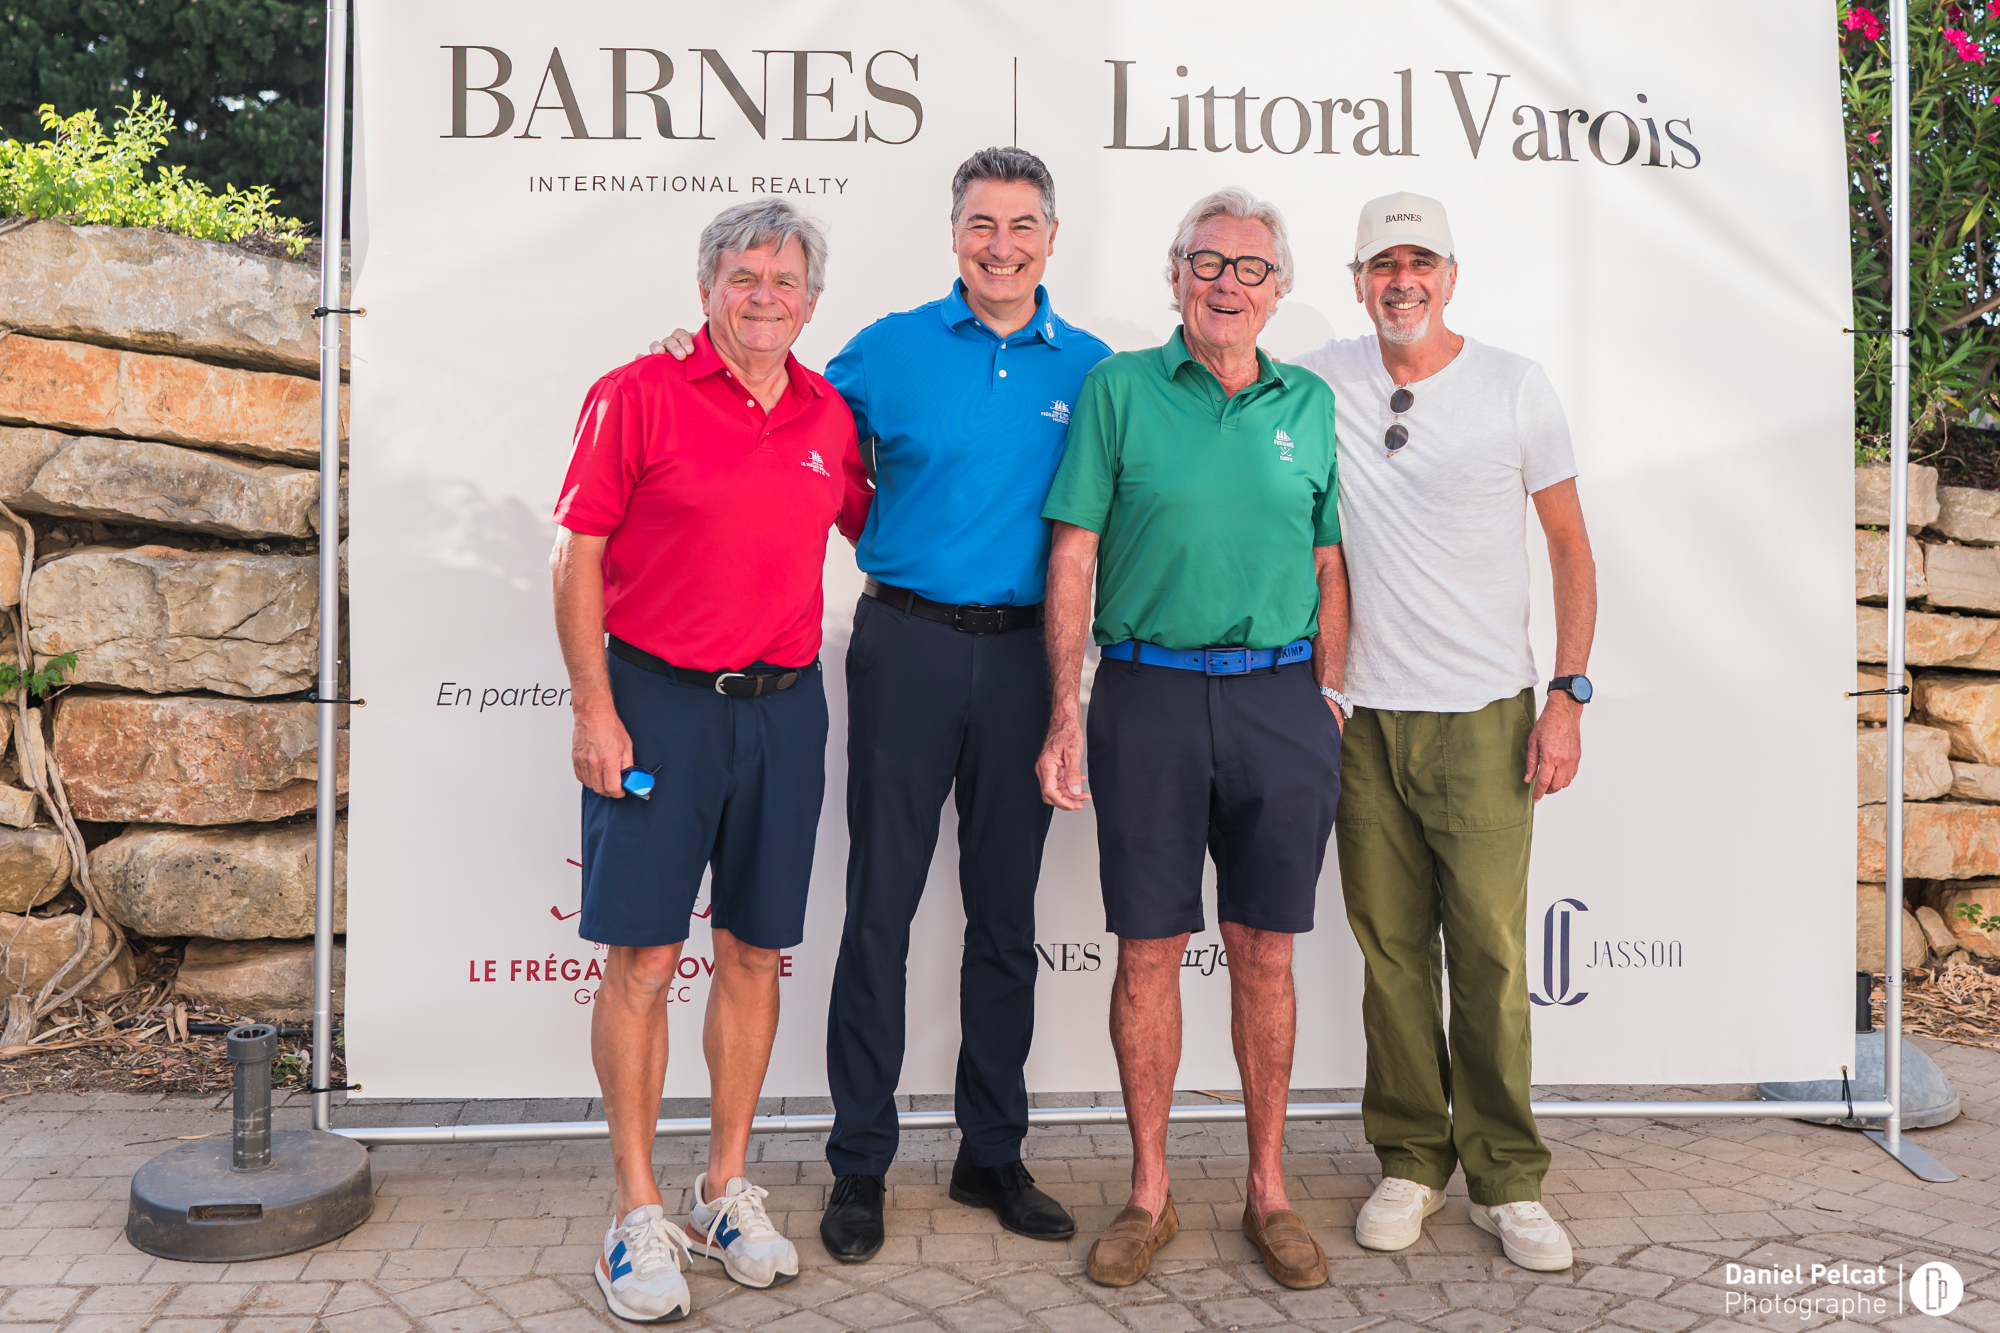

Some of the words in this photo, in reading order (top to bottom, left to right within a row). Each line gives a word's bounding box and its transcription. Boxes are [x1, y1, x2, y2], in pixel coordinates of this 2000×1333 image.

[440, 45, 923, 145] BARNES
[1103, 59, 1421, 157] Littoral
[1434, 70, 1702, 170] Varois
[529, 175, 739, 193] INTERNATIONAL
[752, 177, 849, 194] REALTY
[1385, 213, 1422, 224] BARNES
[1280, 645, 1304, 659] KIMP
[436, 682, 472, 706] En
[479, 682, 572, 713] parten
[470, 959, 497, 982] LE
[510, 953, 607, 982] FRÉGA
[1034, 942, 1102, 972] NES
